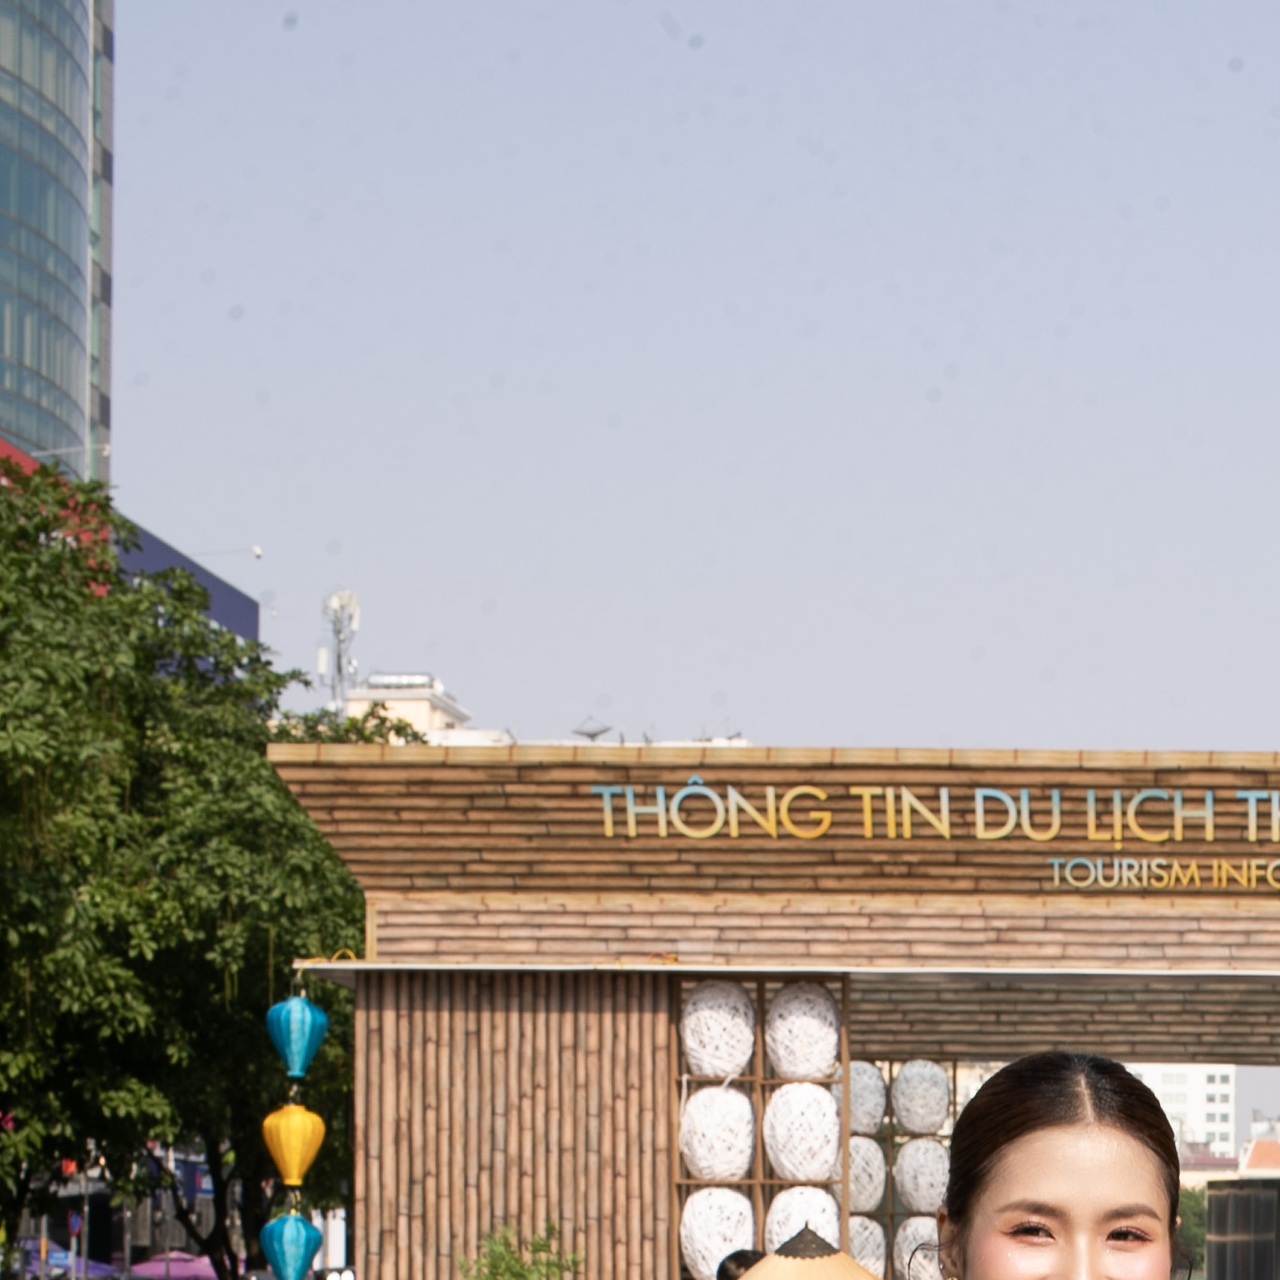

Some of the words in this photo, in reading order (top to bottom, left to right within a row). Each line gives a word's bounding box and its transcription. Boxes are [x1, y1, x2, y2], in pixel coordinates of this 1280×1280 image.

[590, 775, 832, 840] THÔNG
[850, 786, 951, 840] TIN
[975, 788, 1061, 841] DU
[1086, 788, 1215, 850] LỊCH
[1049, 858, 1203, 889] TOURISM
